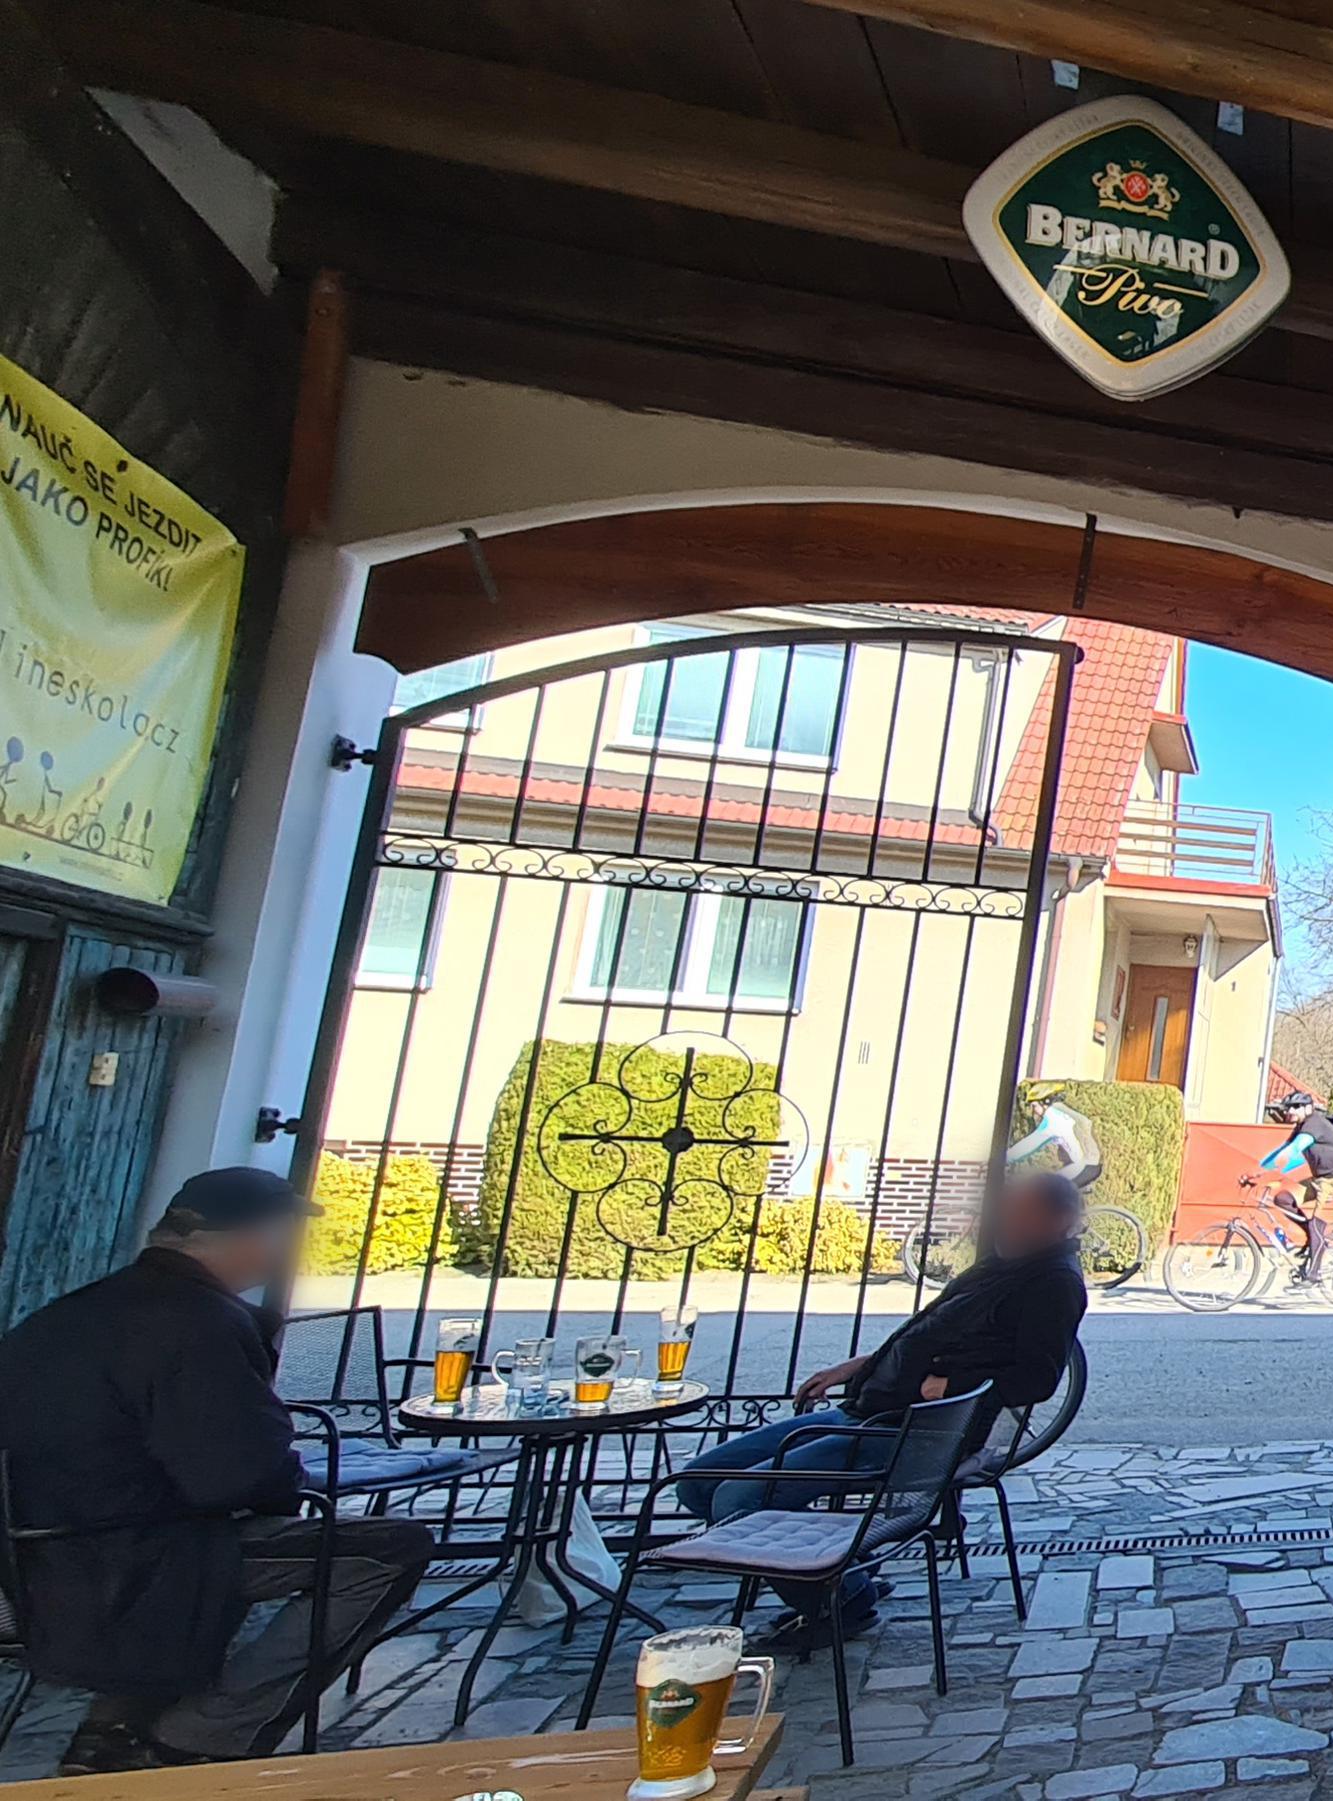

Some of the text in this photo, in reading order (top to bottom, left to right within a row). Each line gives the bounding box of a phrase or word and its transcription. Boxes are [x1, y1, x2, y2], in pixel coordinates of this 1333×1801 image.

[1025, 203, 1240, 281] BERNARD
[1077, 263, 1184, 319] Pivo
[0, 394, 202, 558] NAUČ SE JEZDIT
[0, 456, 89, 526] JAKO
